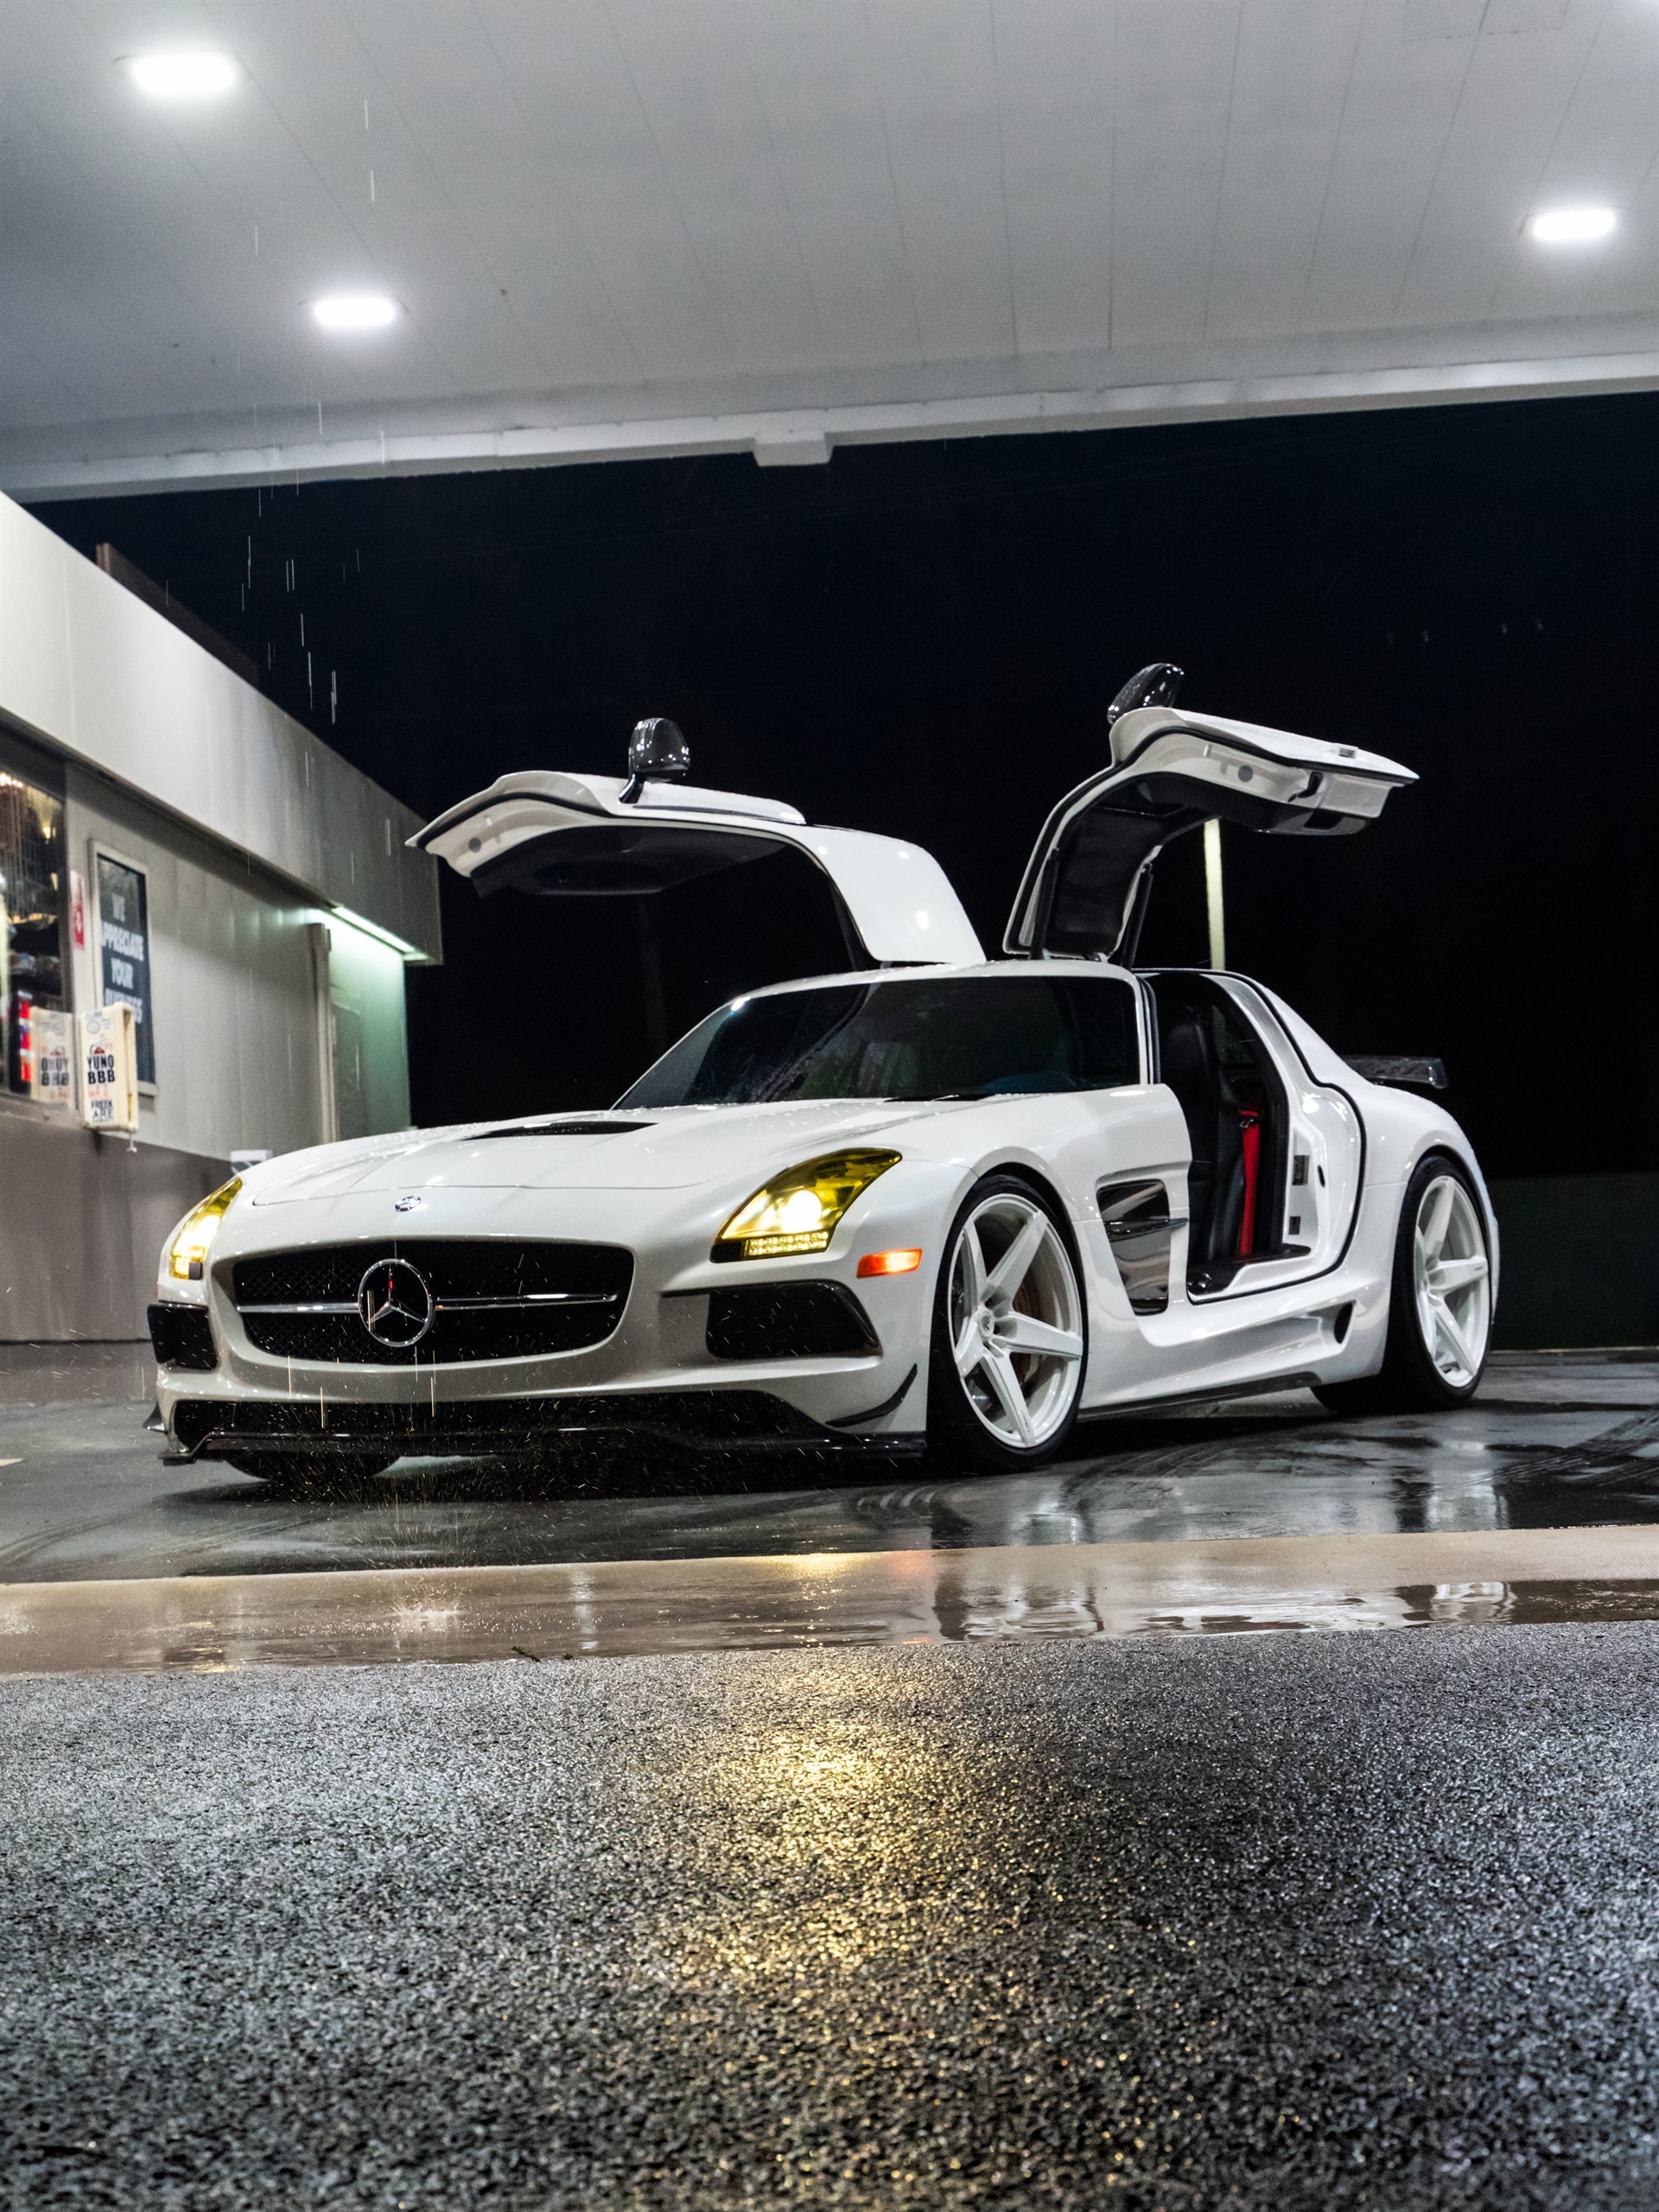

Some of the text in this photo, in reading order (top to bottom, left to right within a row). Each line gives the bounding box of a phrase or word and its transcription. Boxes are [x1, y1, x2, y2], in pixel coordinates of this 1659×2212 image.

[112, 892, 125, 922] WE
[111, 957, 134, 990] YOUR
[87, 1070, 116, 1084] BBB
